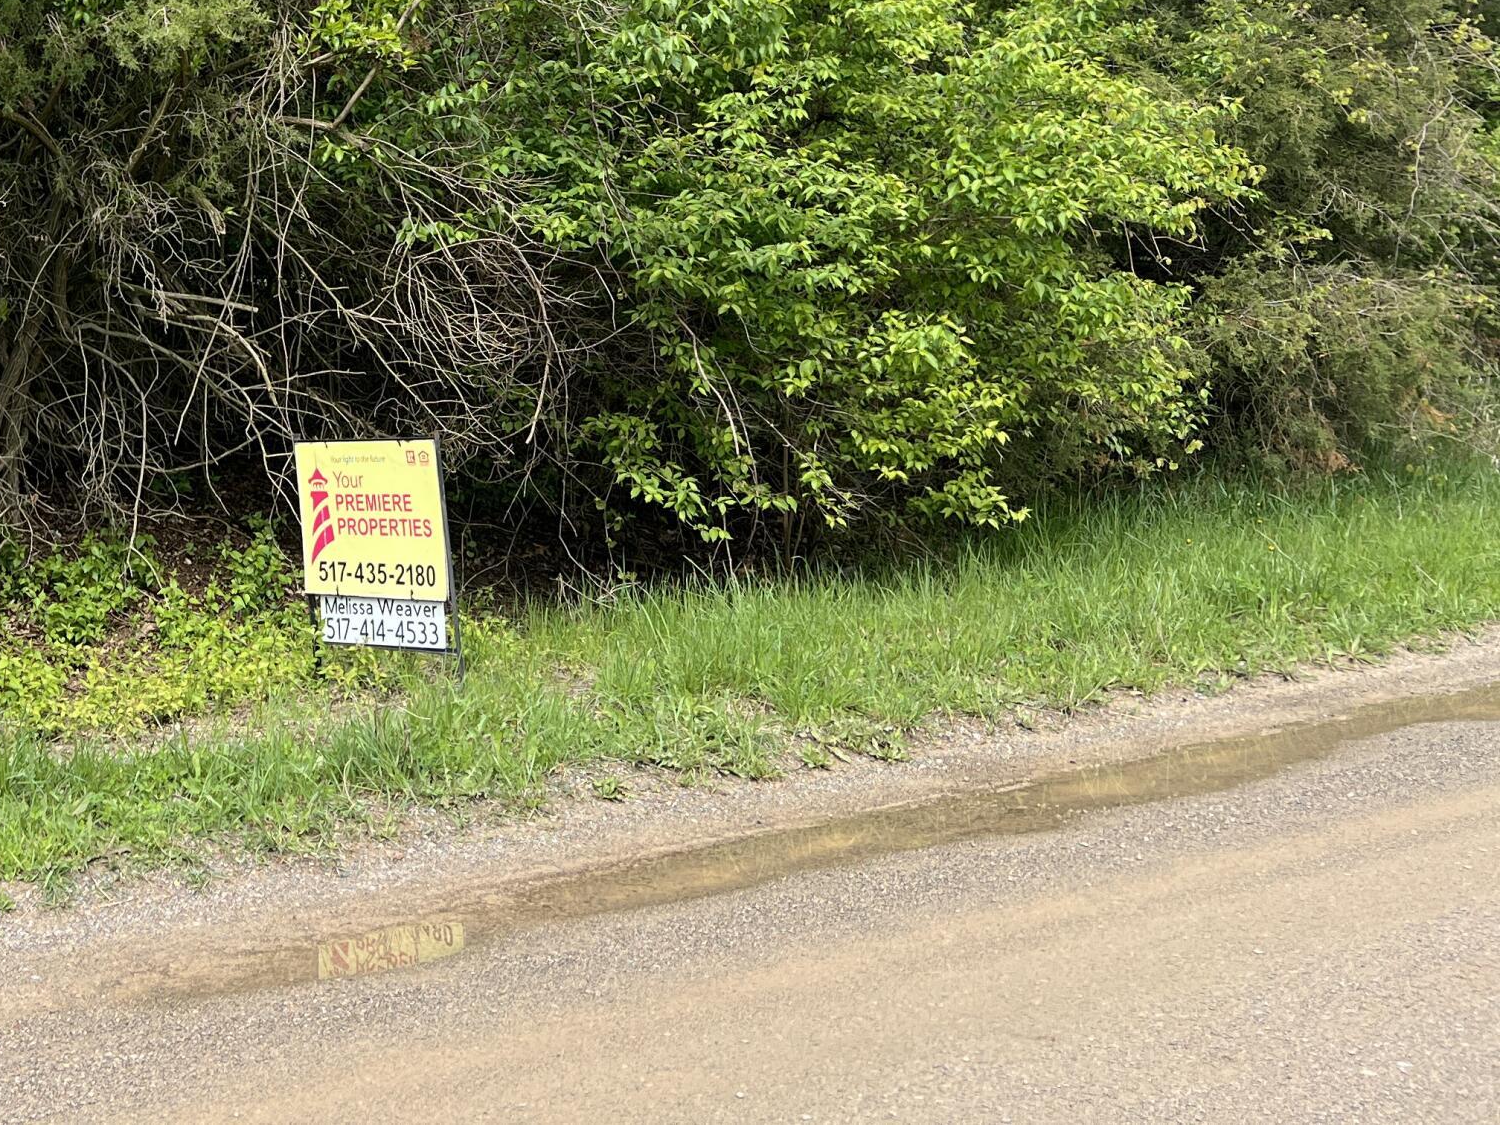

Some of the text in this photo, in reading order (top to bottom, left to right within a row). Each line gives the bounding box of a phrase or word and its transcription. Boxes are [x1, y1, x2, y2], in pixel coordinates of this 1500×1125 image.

[333, 471, 363, 488] Your
[335, 494, 413, 512] PREMIERE
[337, 517, 432, 538] PROPERTIES
[319, 561, 436, 587] 517-435-2180
[325, 597, 437, 618] Melissa Weaver
[326, 617, 439, 645] 517-414-4533
